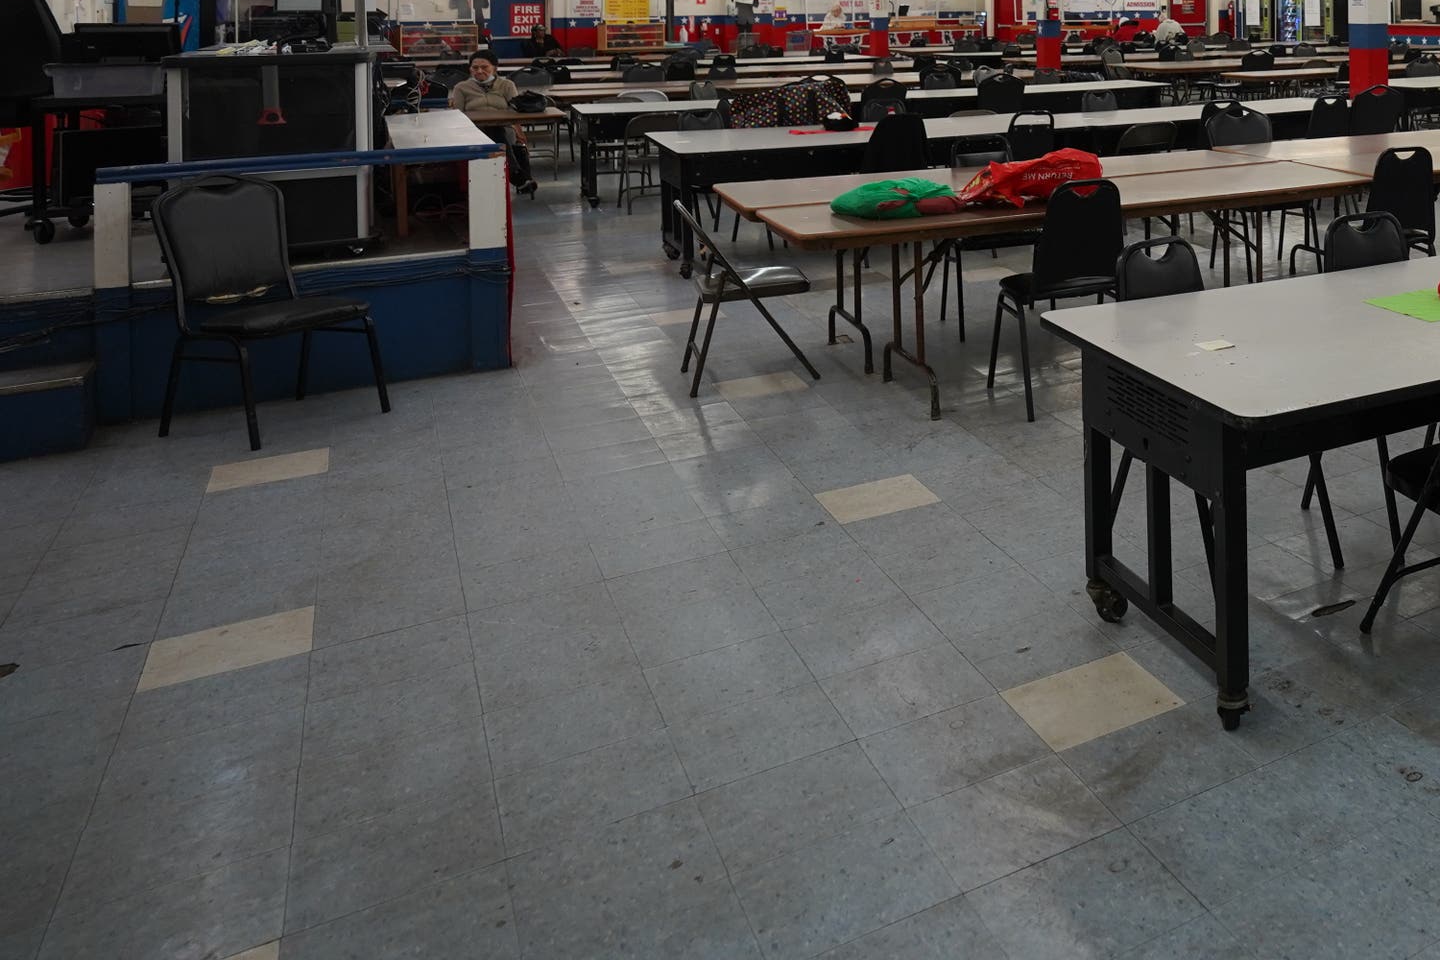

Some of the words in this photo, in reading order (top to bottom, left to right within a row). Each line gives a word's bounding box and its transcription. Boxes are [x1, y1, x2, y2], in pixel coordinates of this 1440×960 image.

[514, 5, 540, 14] FIRE
[514, 15, 541, 24] EXIT
[1038, 172, 1073, 180] RETURN
